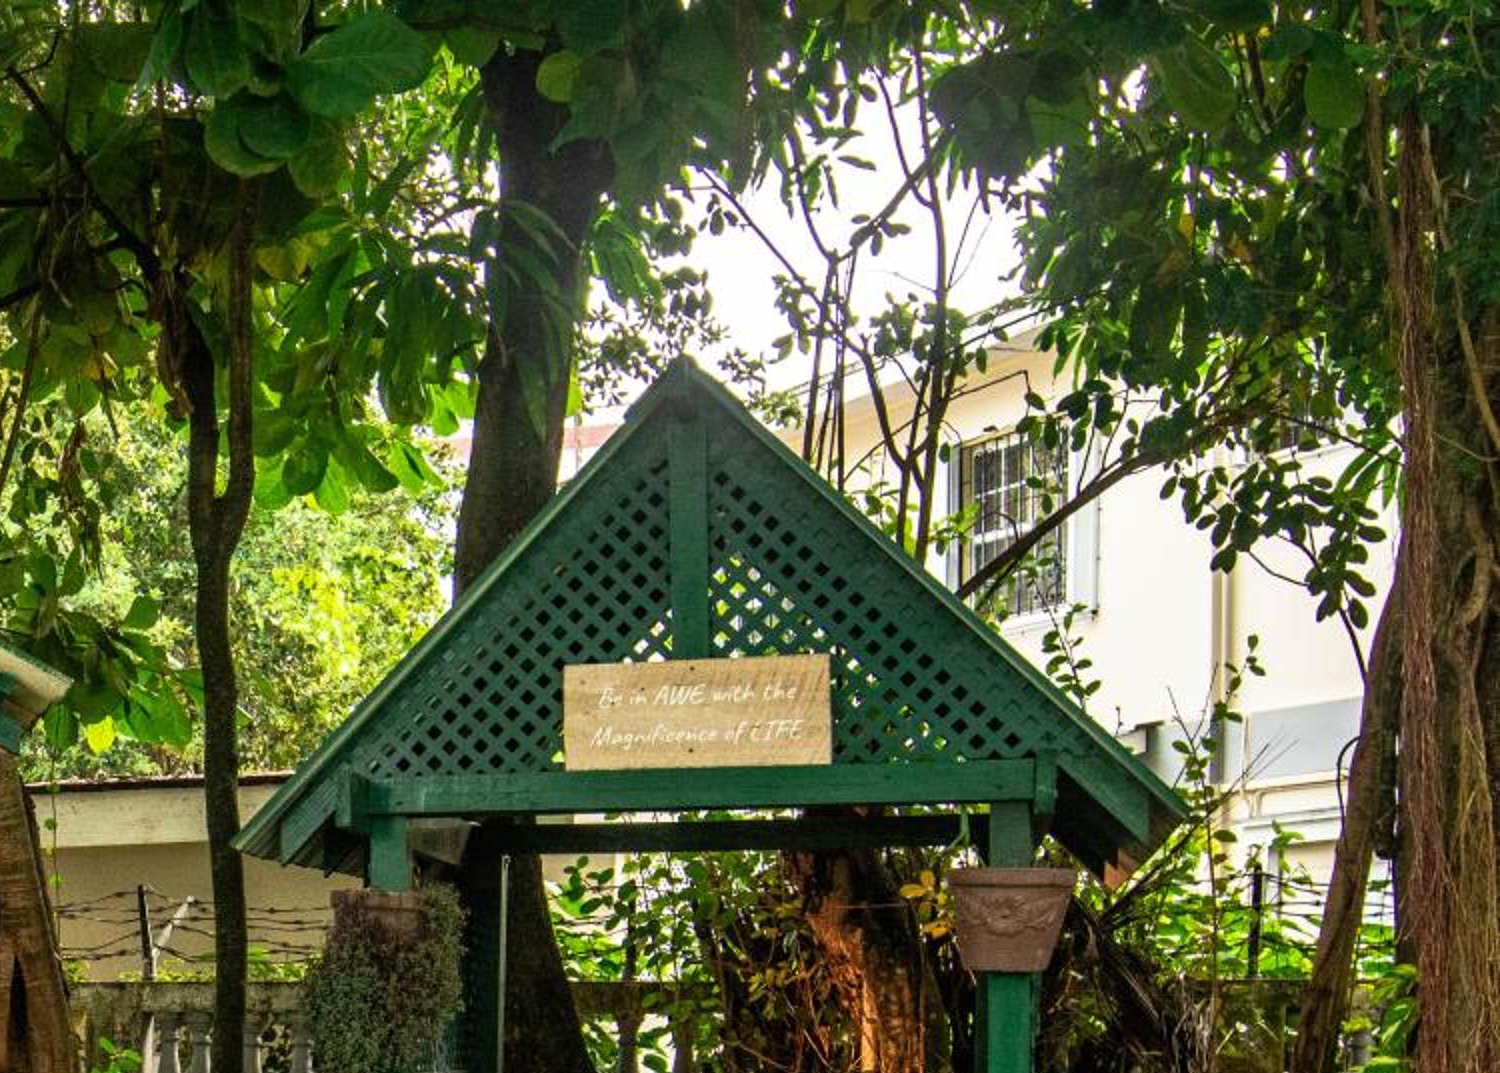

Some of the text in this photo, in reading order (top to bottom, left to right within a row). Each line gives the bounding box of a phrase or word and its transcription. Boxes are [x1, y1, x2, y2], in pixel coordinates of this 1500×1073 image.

[629, 691, 646, 705] in
[653, 683, 706, 705] AWE
[713, 683, 755, 702] with
[763, 682, 797, 701] the
[590, 719, 804, 750] Magnificence of LIFE
